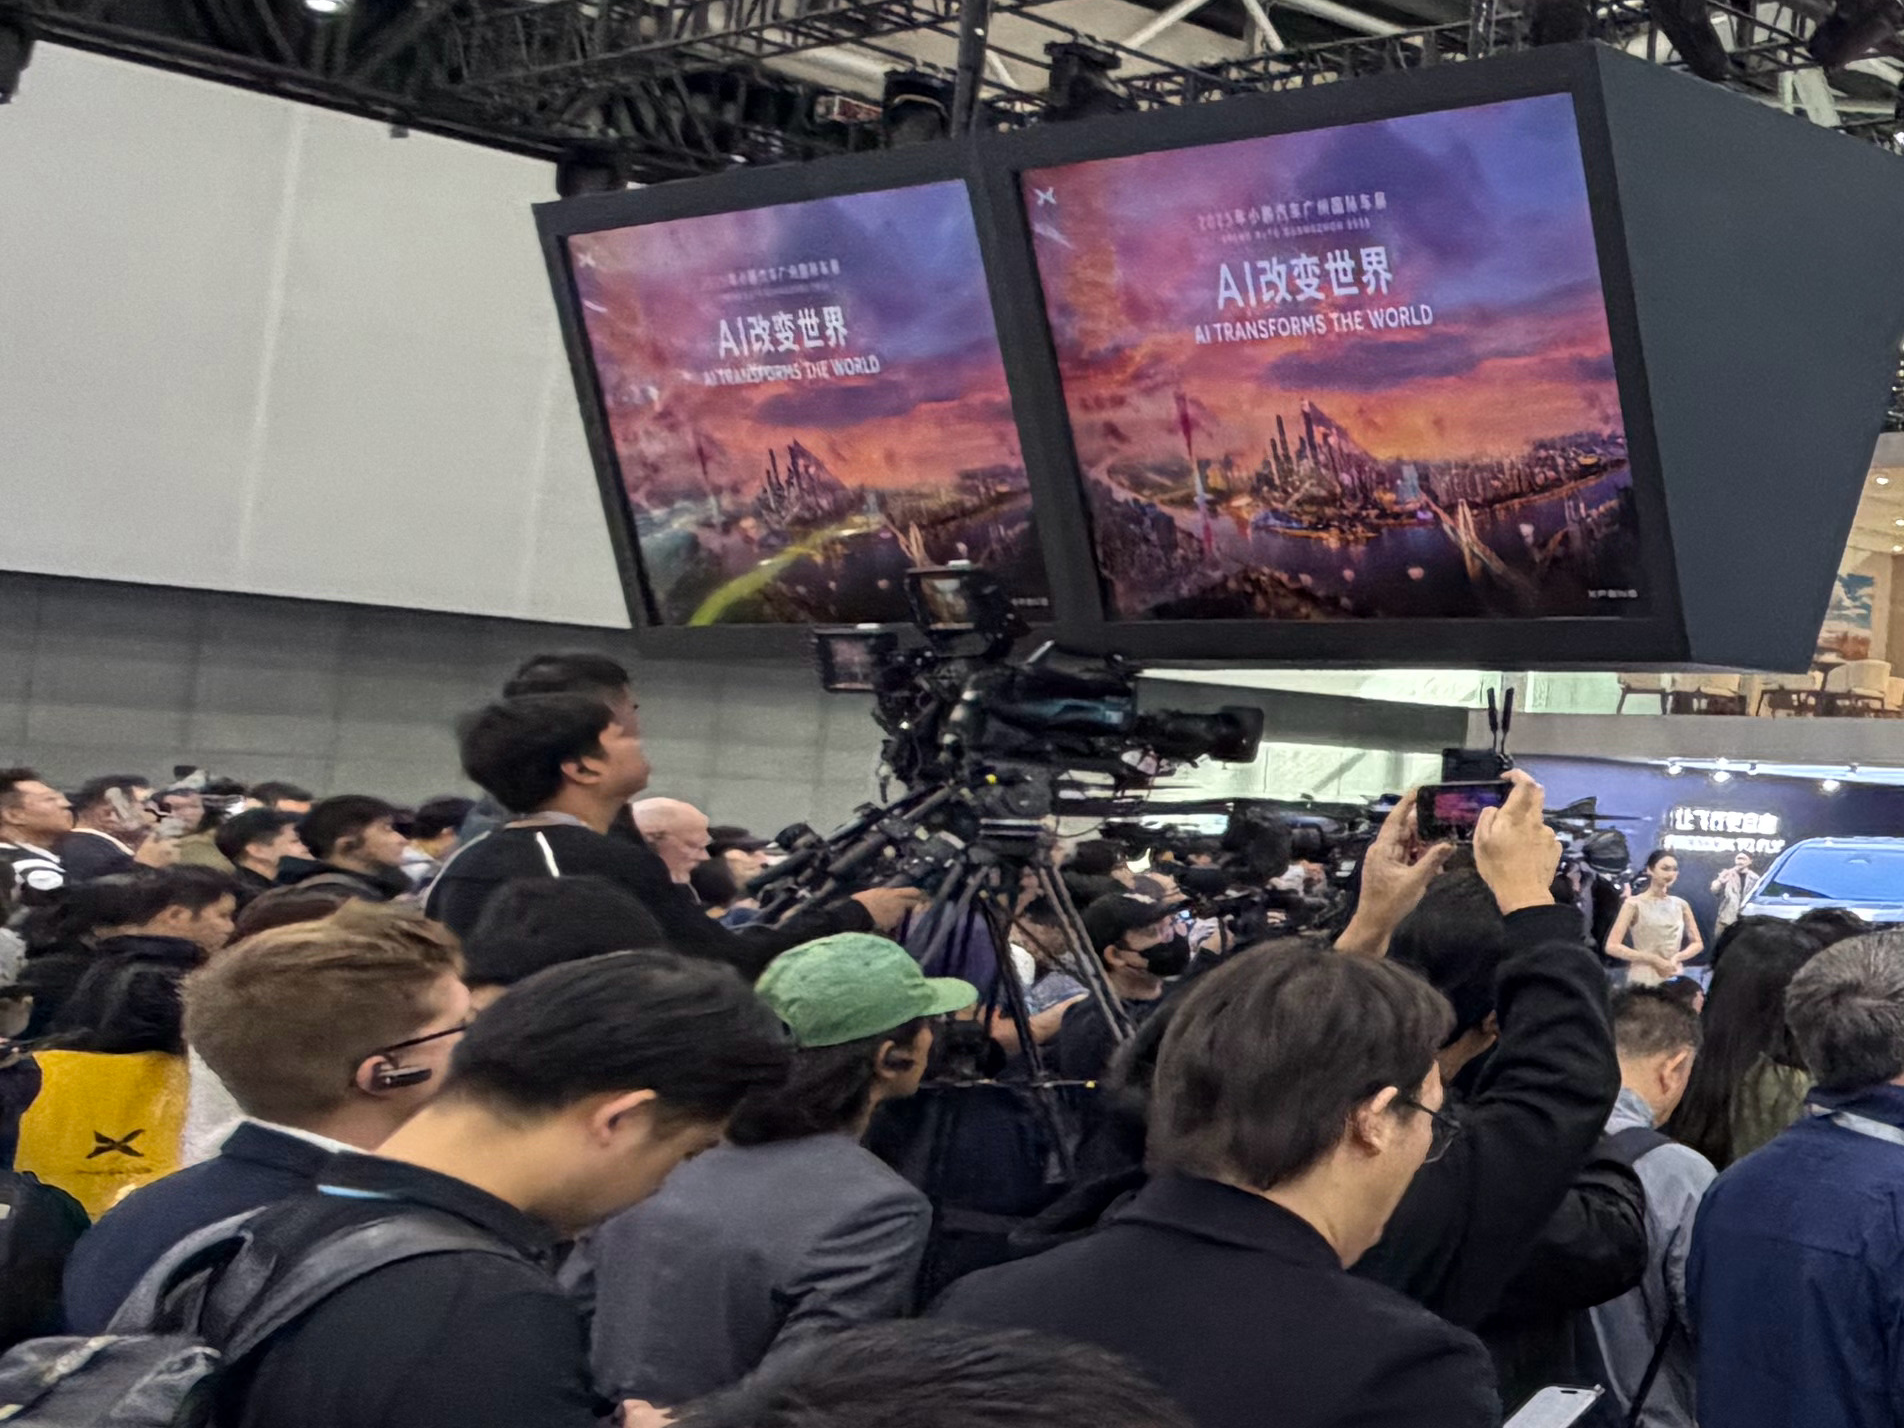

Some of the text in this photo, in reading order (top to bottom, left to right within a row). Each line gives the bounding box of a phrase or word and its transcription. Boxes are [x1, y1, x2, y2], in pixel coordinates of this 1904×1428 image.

[1217, 245, 1393, 310] AI改变世界
[718, 305, 849, 359] AI改变世界
[1194, 304, 1434, 345] AI TRANSFORMS THE WORLD
